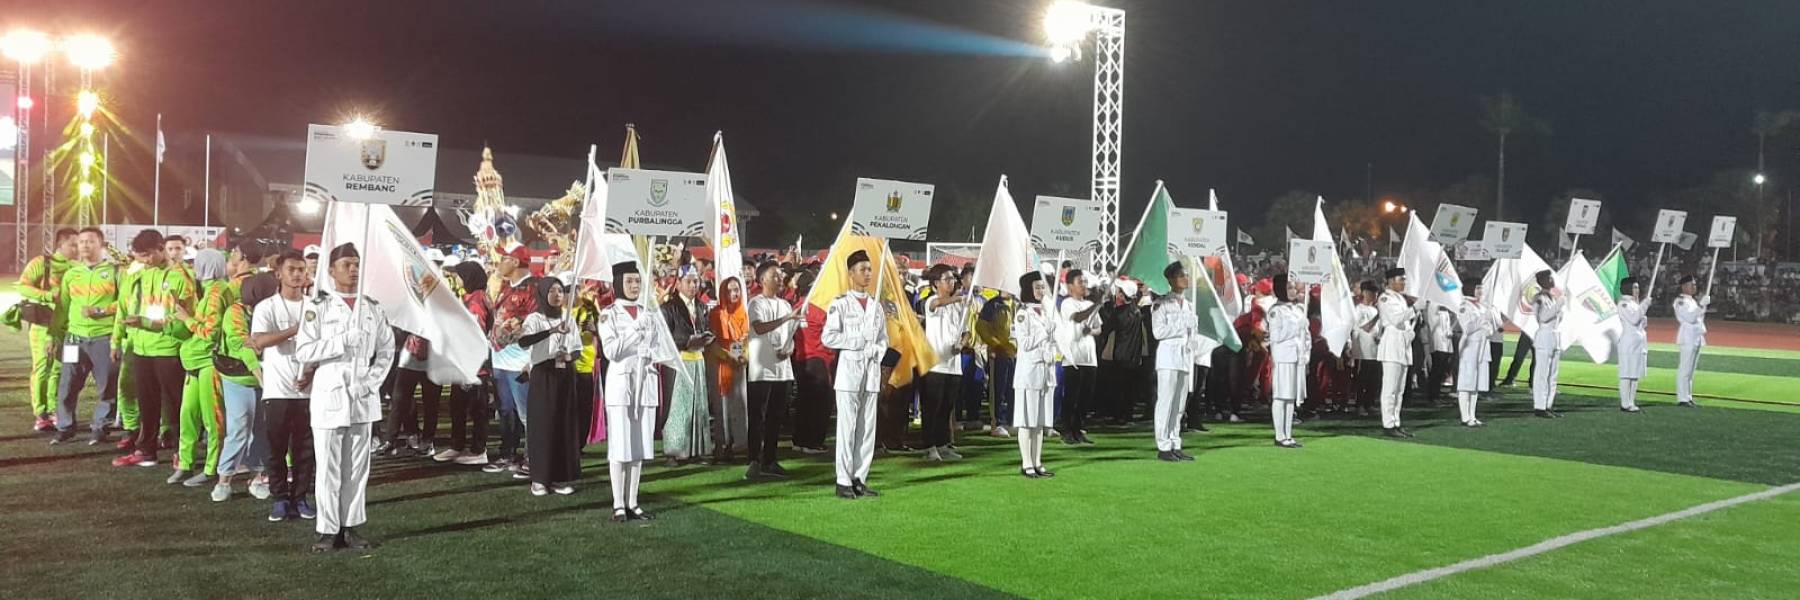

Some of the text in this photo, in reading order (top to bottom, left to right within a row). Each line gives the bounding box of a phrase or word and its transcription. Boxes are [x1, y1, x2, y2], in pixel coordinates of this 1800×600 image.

[343, 174, 400, 184] KABUPATEN
[346, 183, 396, 193] REMBANG
[634, 209, 678, 217] KABUPATEN
[628, 217, 683, 225] PURBALINGGA
[870, 221, 911, 230] PEKALONGAN
